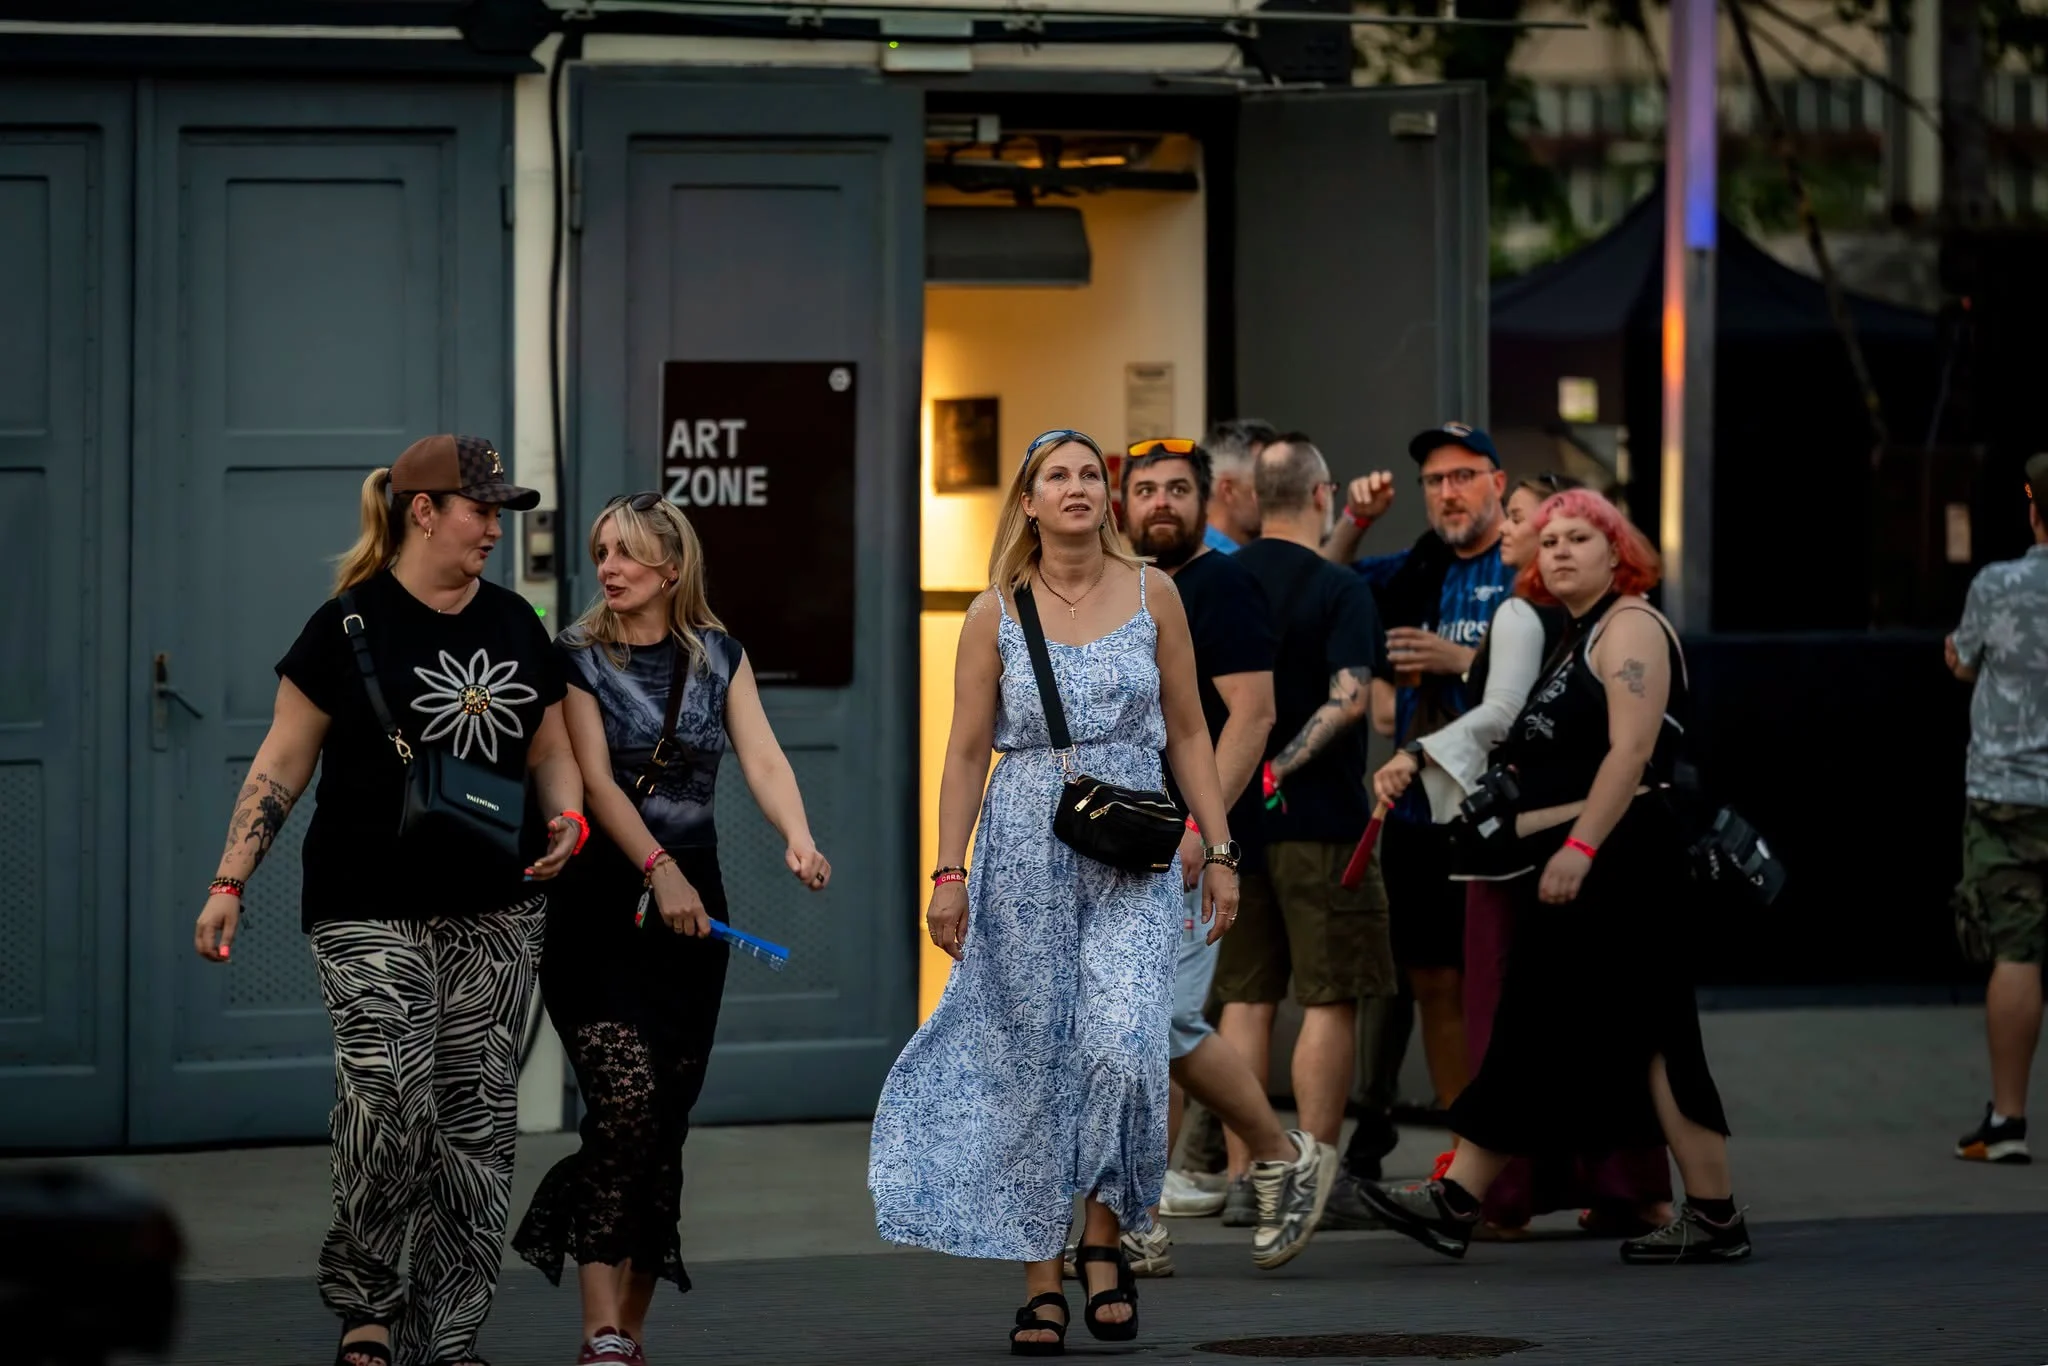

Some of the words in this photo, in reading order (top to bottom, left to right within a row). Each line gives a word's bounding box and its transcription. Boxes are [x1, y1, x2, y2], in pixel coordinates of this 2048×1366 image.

[666, 419, 747, 458] ART
[665, 466, 768, 506] ZONE
[466, 793, 500, 812] VALENTINO
